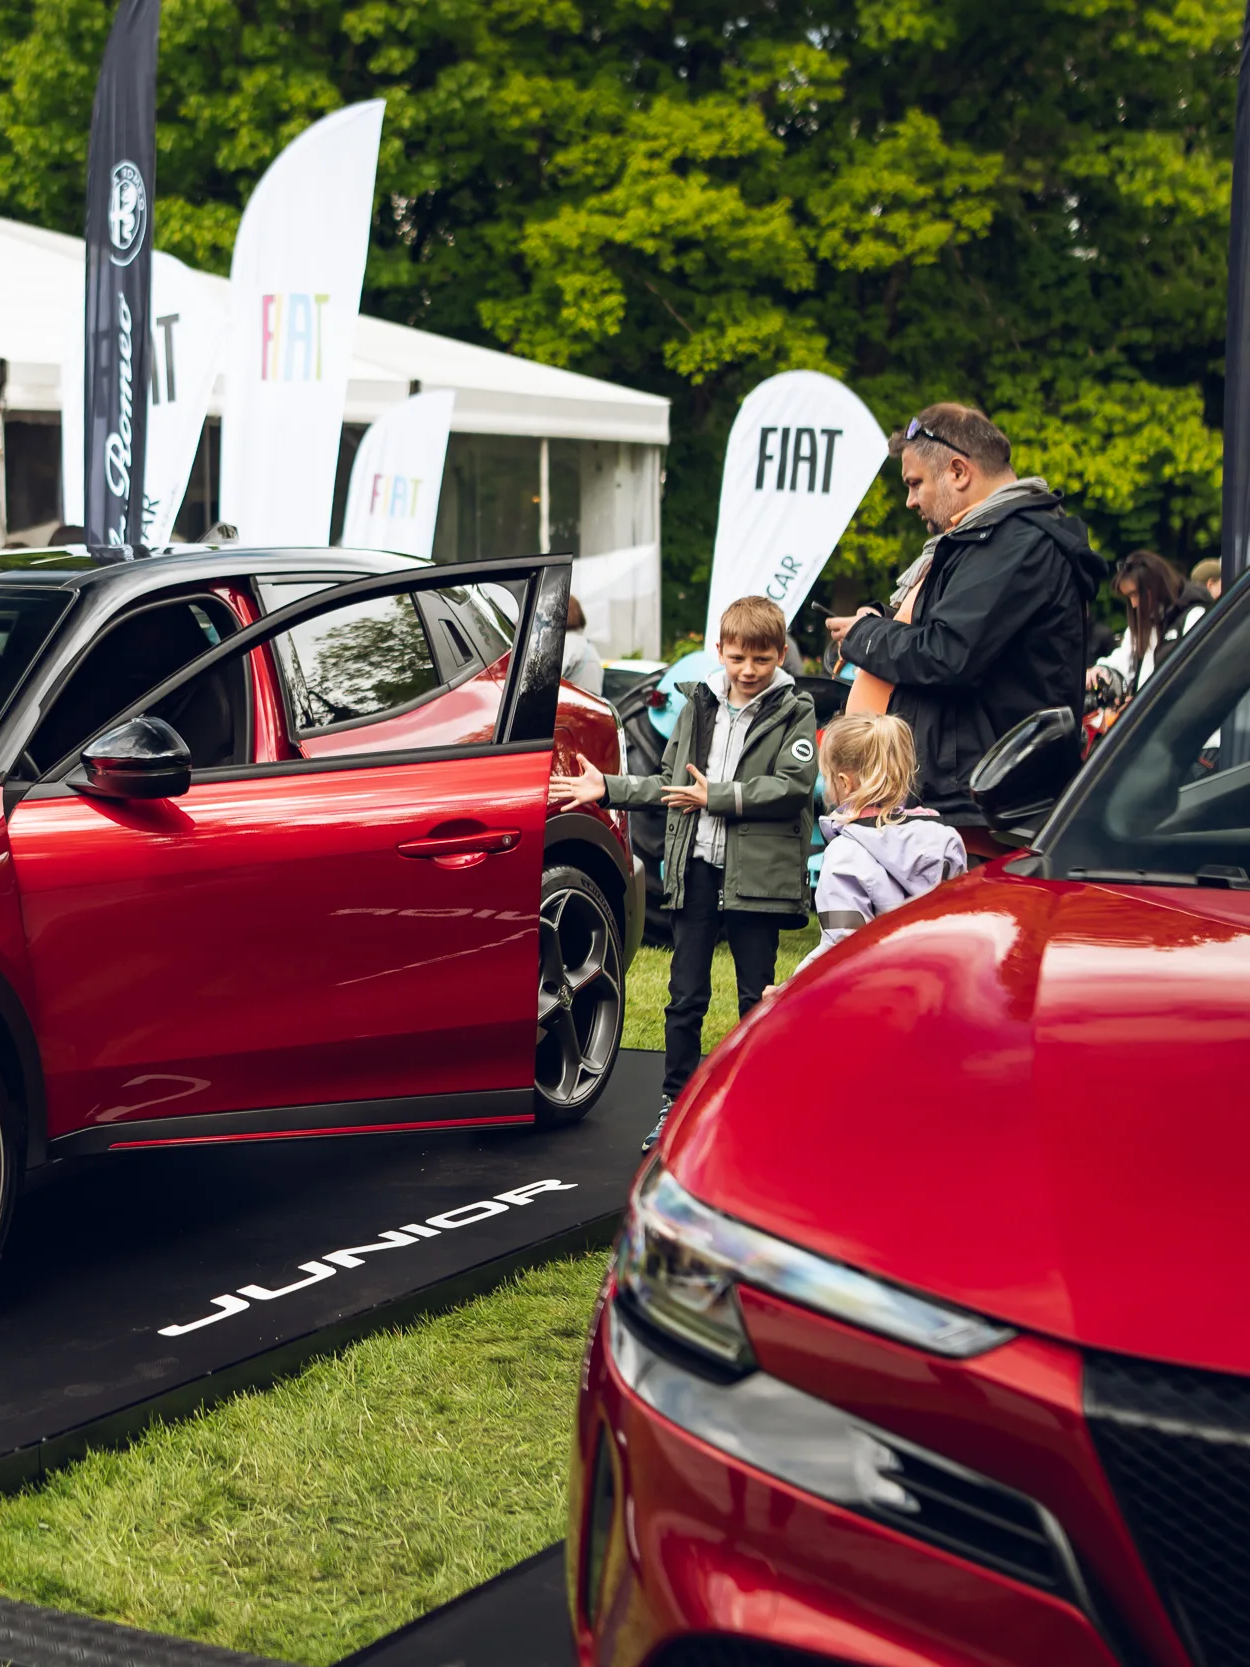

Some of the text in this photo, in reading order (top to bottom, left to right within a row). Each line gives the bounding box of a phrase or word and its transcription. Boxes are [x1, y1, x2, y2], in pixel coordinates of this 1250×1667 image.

[261, 292, 331, 381] FIAT
[105, 291, 133, 500] Romeo
[370, 474, 423, 517] FIAT
[755, 427, 844, 493] FIAT
[766, 555, 803, 601] CAR
[157, 1179, 579, 1337] JUNIOR
